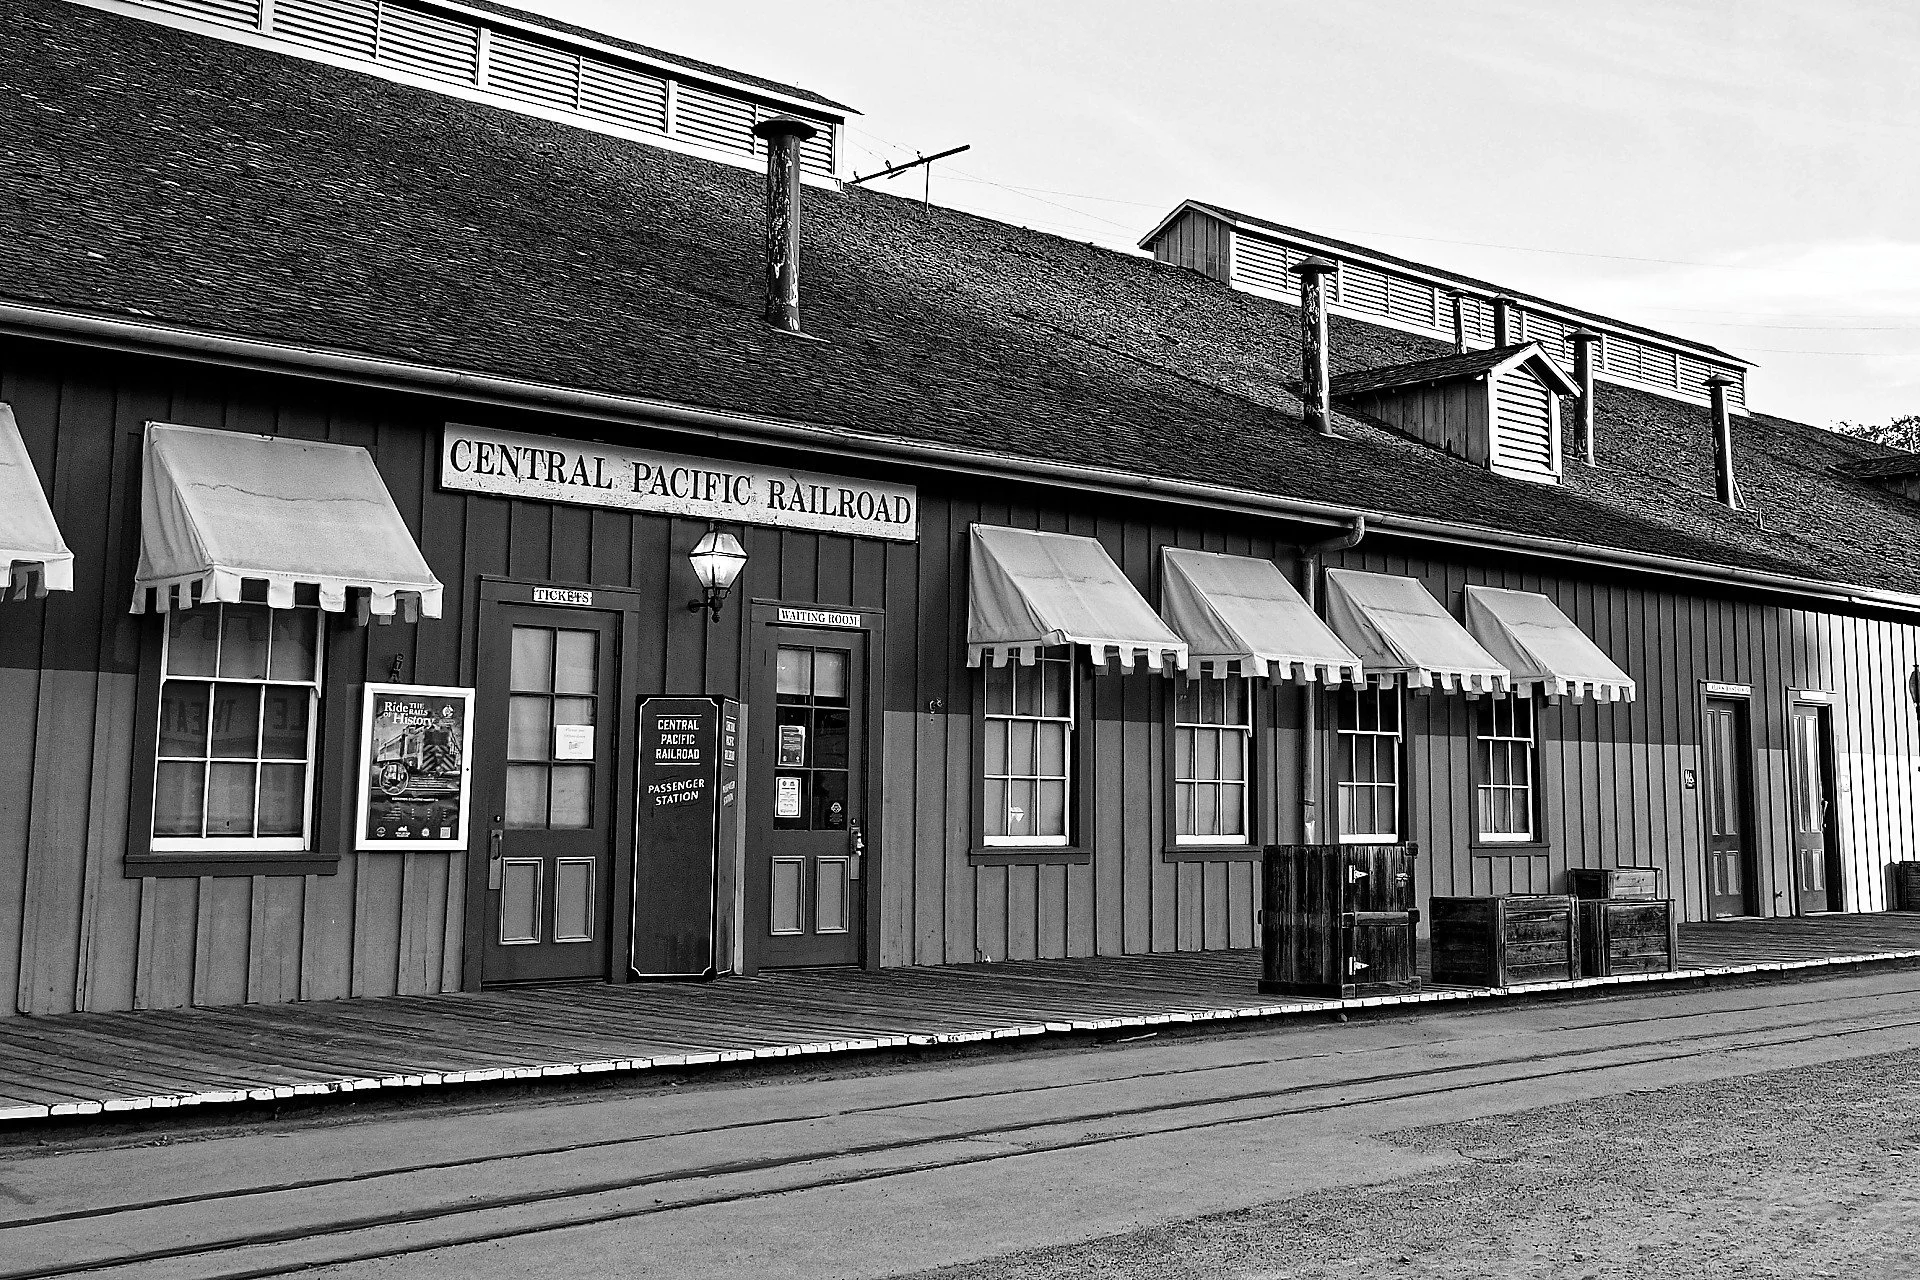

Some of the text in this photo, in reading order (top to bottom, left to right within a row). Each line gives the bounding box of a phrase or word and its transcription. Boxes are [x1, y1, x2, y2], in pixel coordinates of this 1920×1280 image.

[449, 438, 911, 525] CENTRAL PACIFIC RAILROAD
[536, 589, 589, 603] TICKETS
[781, 609, 857, 626] WAITING ROOM
[384, 701, 409, 713] Ride
[409, 702, 425, 710] THE
[409, 708, 428, 716] RAILS
[392, 712, 435, 730] History
[657, 719, 700, 731] CENTRAL
[660, 734, 696, 745] PACIFIC
[655, 748, 700, 760] RAILROAD
[648, 778, 705, 794] PASSENGER
[655, 790, 699, 806] STATION
